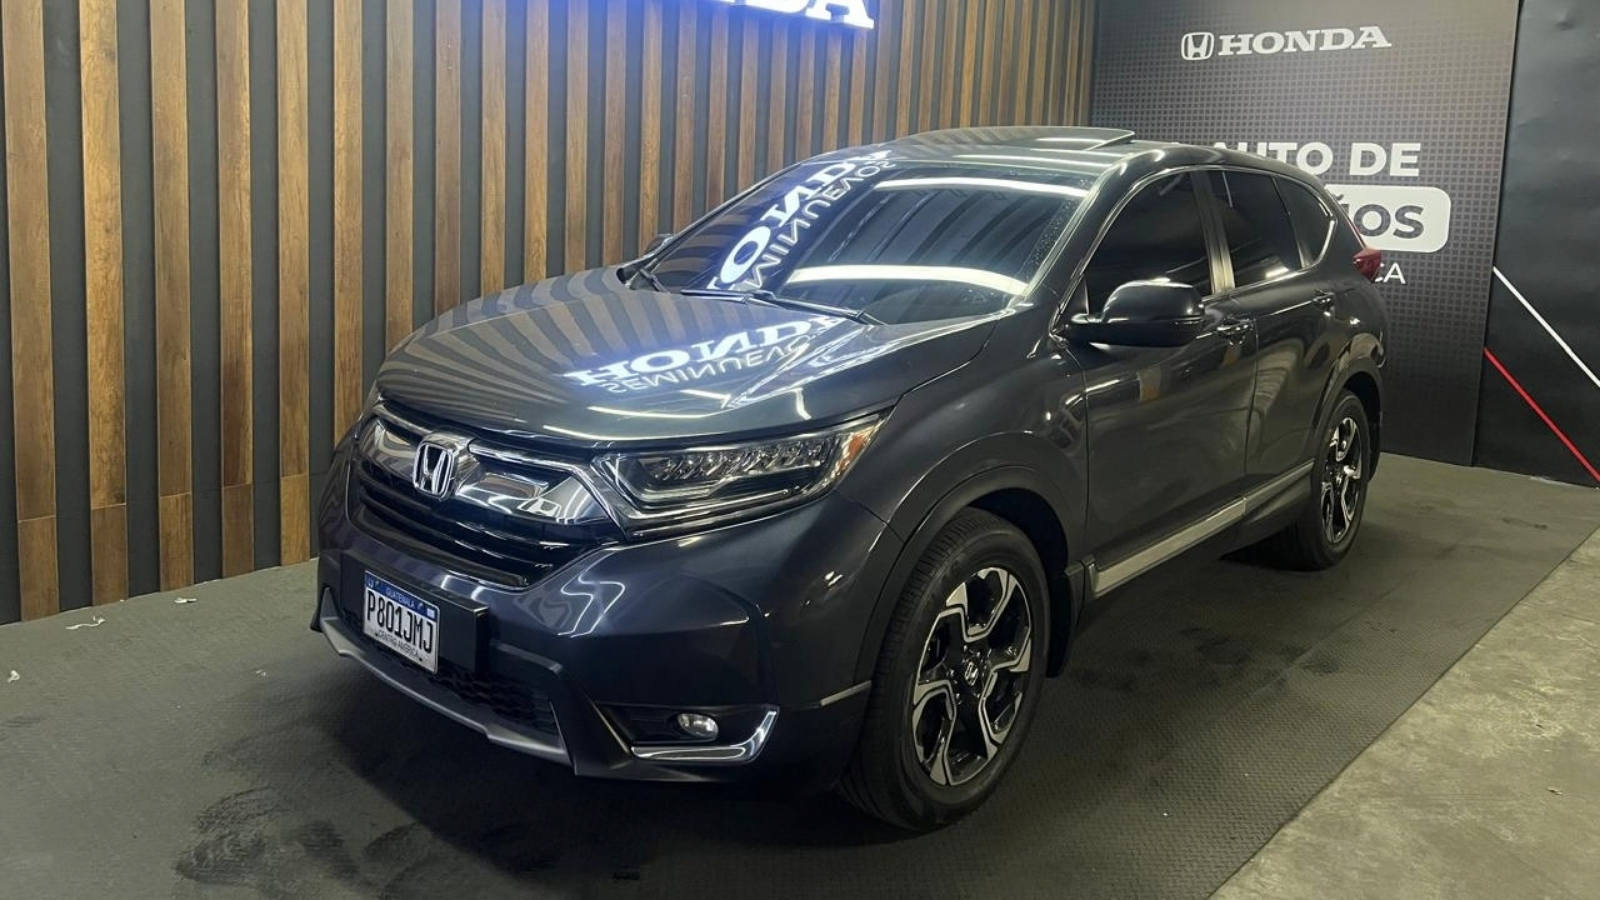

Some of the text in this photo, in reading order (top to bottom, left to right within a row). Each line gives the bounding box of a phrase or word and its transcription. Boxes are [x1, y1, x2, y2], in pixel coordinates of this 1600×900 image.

[1219, 26, 1392, 56] HONDA
[1213, 142, 1421, 177] TO DE
[1331, 193, 1425, 239] OS
[367, 589, 434, 654] P801JMJ
